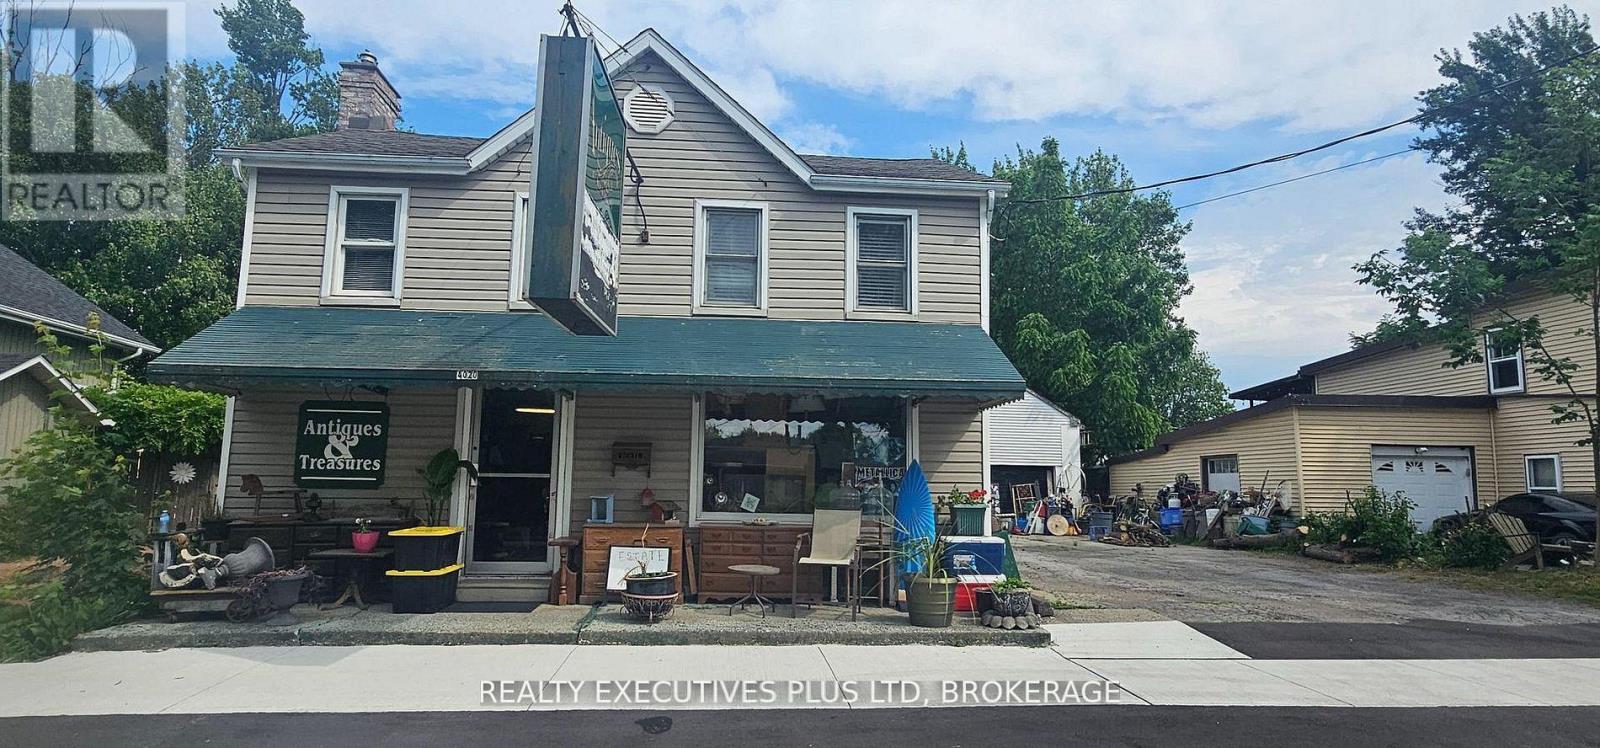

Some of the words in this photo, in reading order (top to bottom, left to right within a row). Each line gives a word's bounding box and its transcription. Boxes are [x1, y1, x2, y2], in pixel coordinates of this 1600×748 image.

[303, 418, 382, 440] Antiques
[324, 431, 359, 461] &
[299, 454, 381, 471] Treasures
